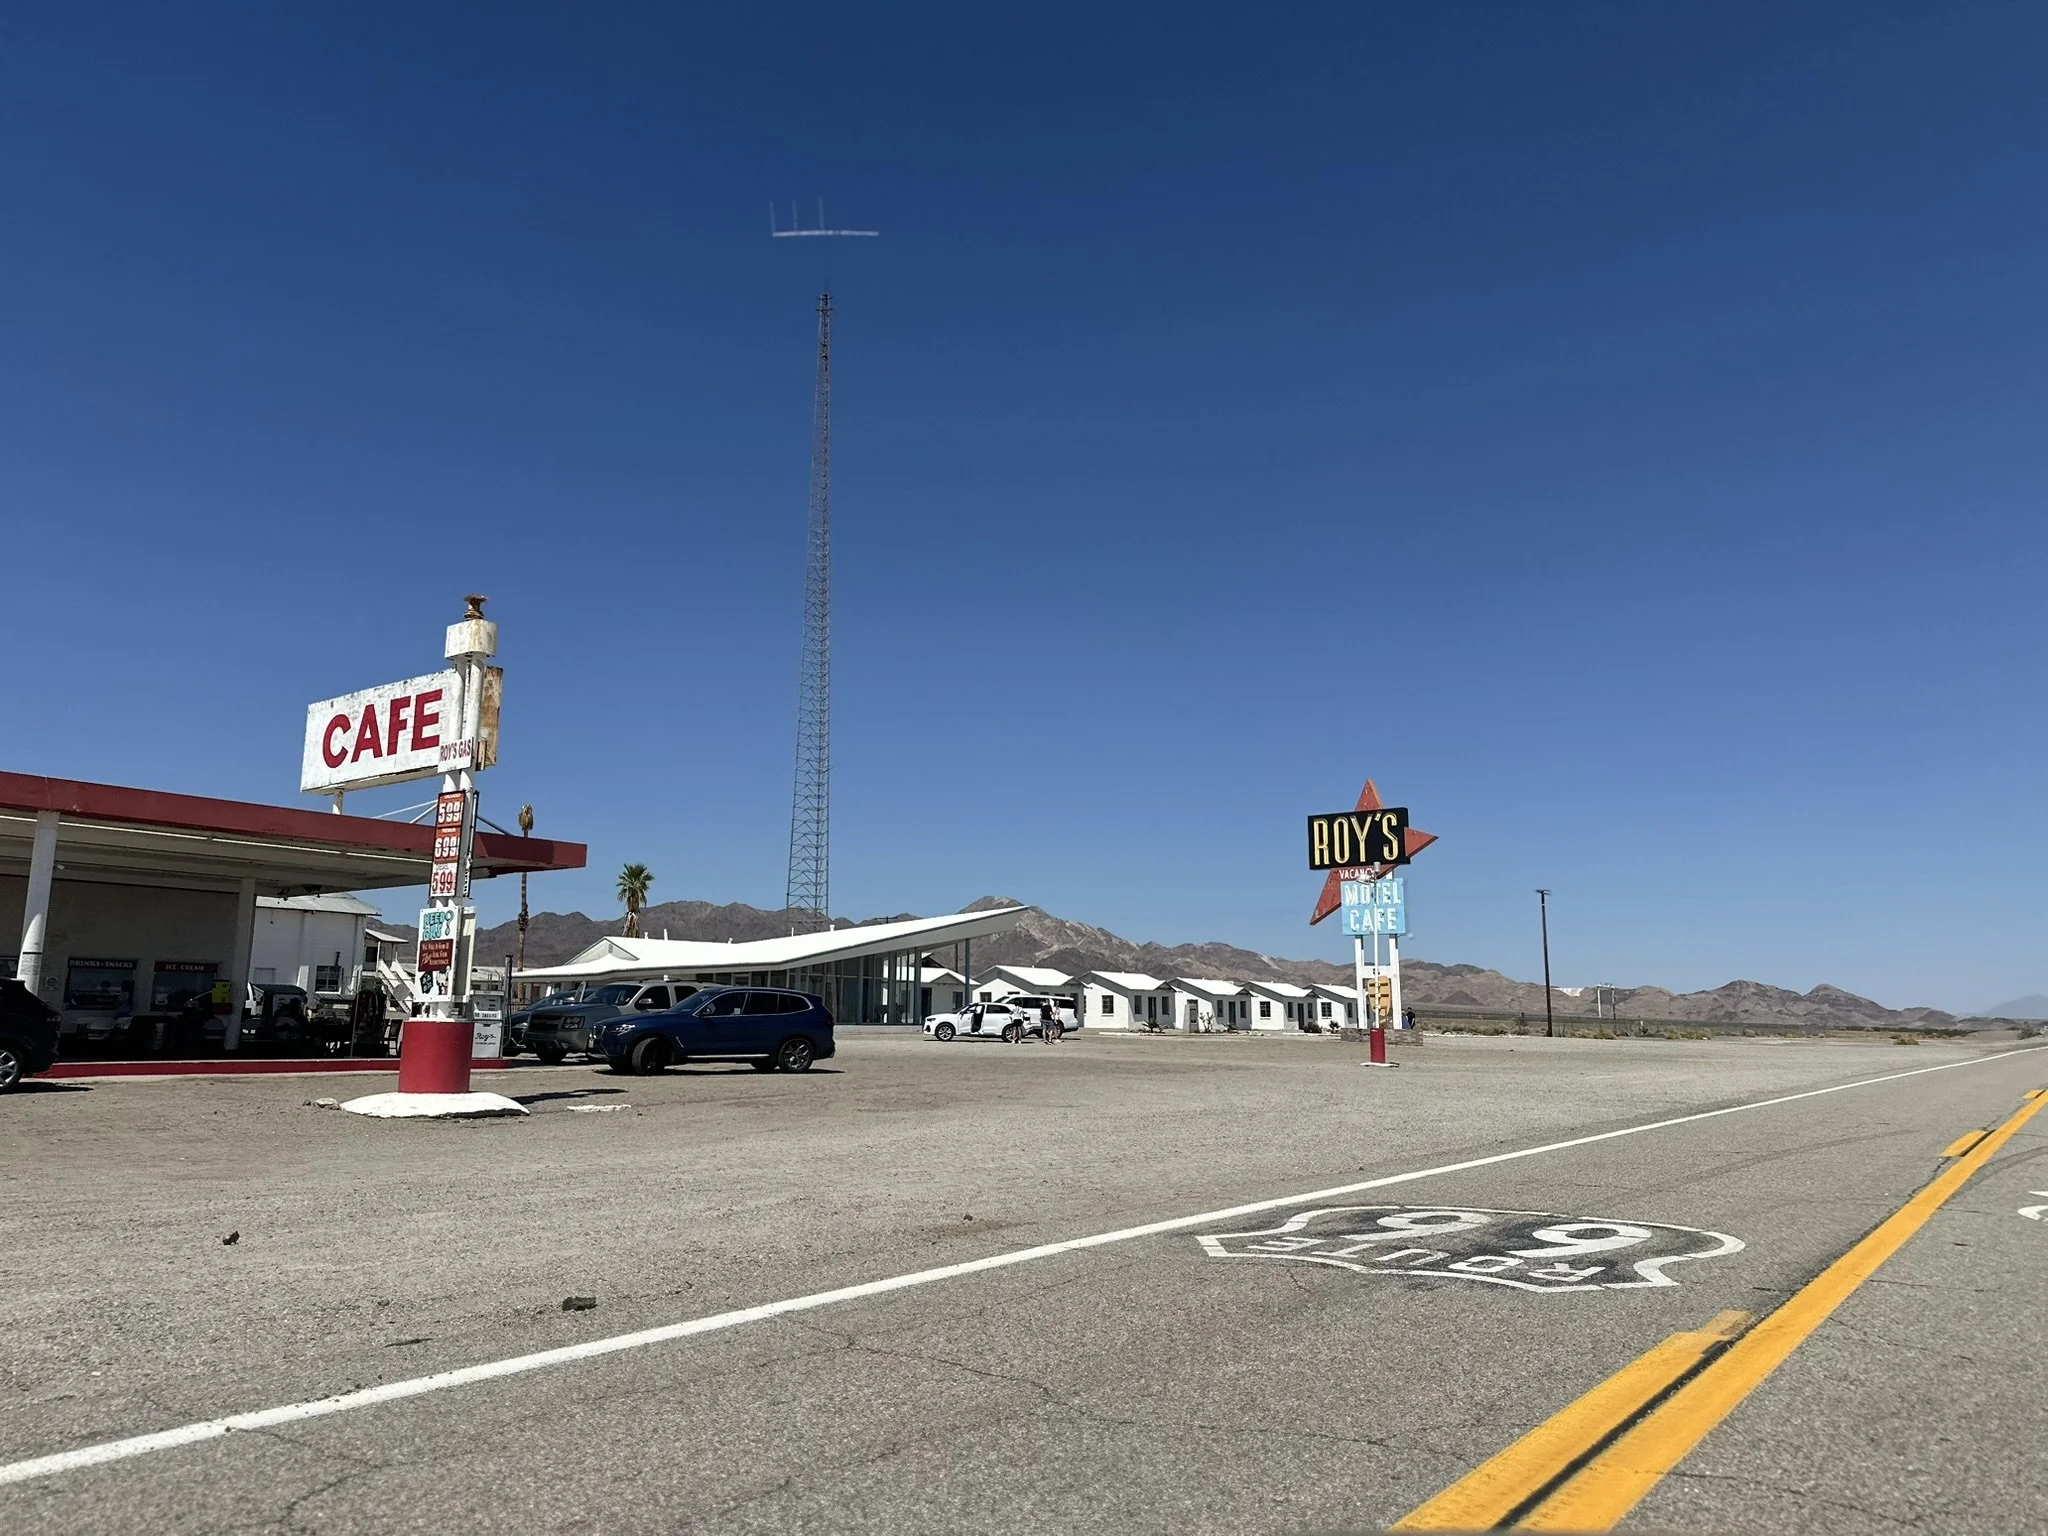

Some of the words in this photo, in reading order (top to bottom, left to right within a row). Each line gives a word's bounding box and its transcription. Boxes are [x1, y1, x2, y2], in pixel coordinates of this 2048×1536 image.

[322, 688, 443, 769] CAFE
[440, 742, 457, 762] ROY'S
[458, 739, 471, 758] GAS
[1313, 811, 1399, 866] ROY'S
[432, 870, 453, 893] 599
[1344, 882, 1401, 907] MOTEL
[423, 912, 445, 929] NEED
[1349, 908, 1397, 932] CAFE
[105, 961, 133, 969] SNACKS
[1340, 1211, 1652, 1258] 66
[1245, 1236, 1605, 1281] ROUTE
